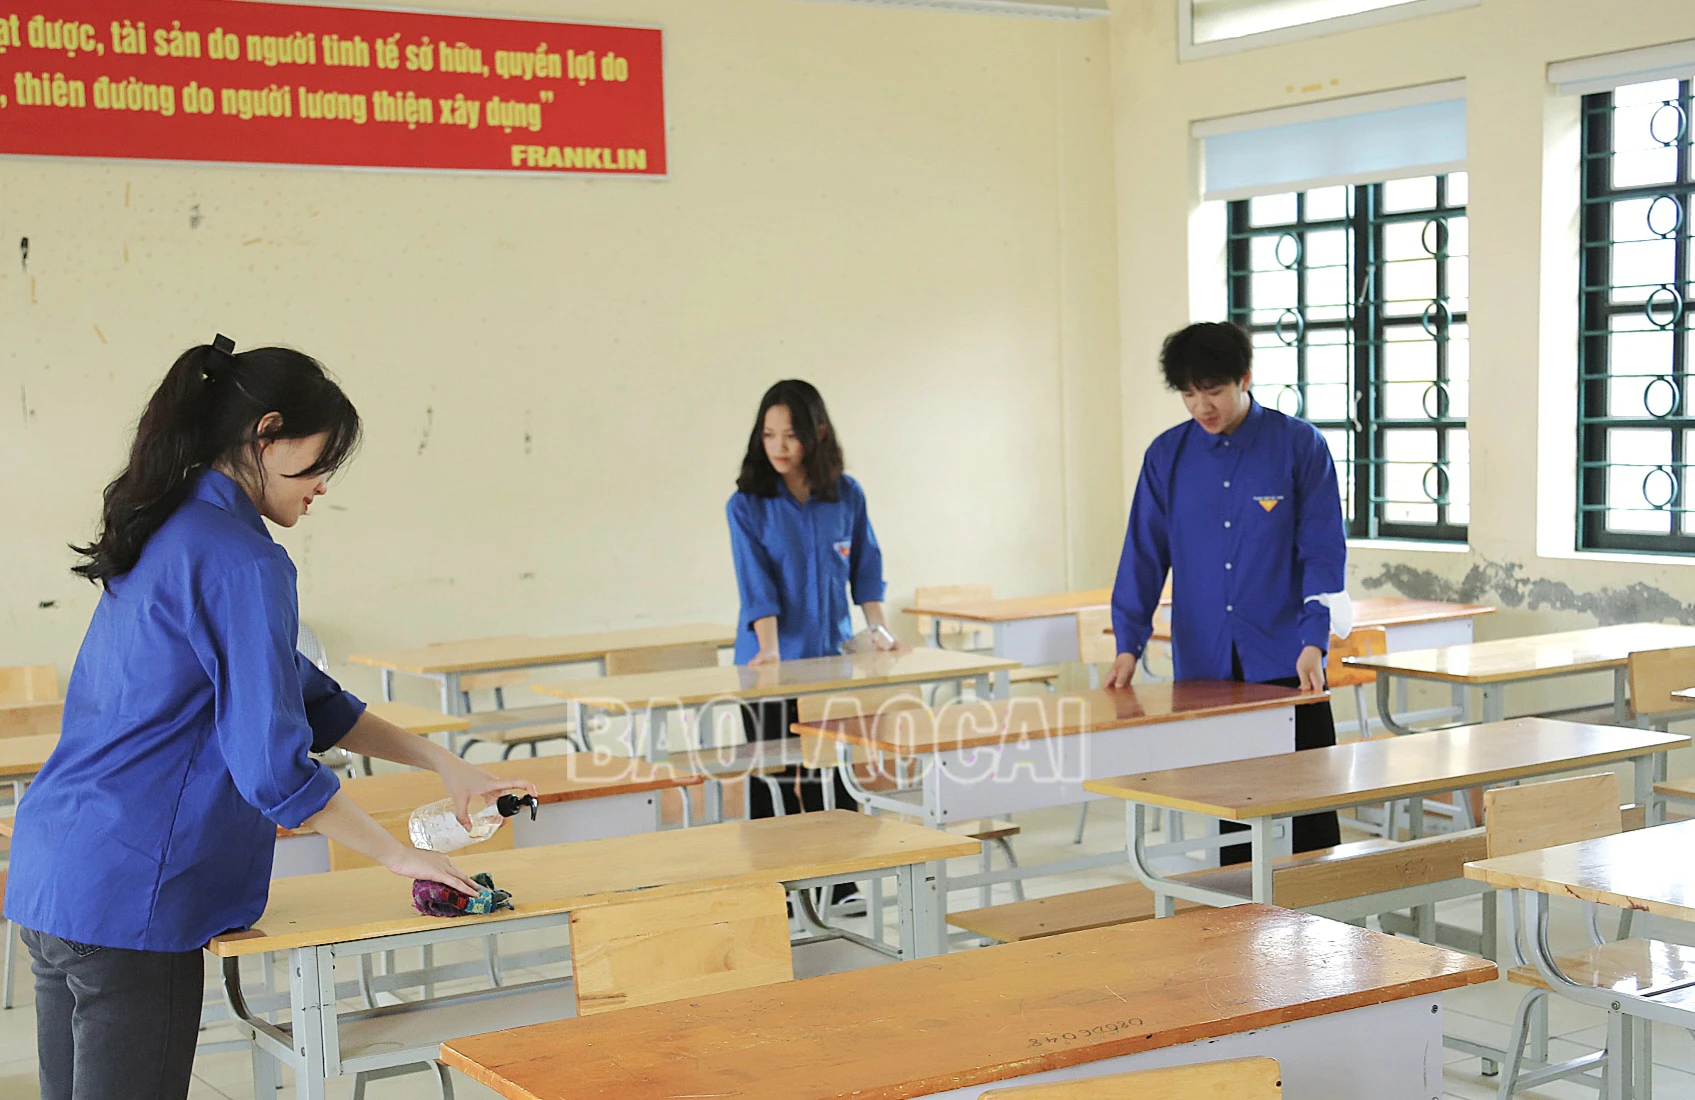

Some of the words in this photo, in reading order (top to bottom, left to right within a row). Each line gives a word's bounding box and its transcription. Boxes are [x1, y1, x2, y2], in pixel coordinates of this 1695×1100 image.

[28, 15, 105, 58] được,
[111, 19, 147, 54] tài
[154, 20, 201, 58] sản
[208, 27, 240, 60] do
[246, 31, 316, 67] người
[322, 34, 370, 67] tinh
[375, 32, 401, 69] tế
[406, 36, 434, 71] sở
[439, 41, 490, 77] hữu,
[567, 49, 596, 86] lợi
[601, 52, 629, 82] do
[14, 71, 86, 108] thiên
[93, 76, 175, 117] đường
[182, 81, 215, 115] do
[221, 84, 292, 120] người
[299, 86, 367, 125] lương
[372, 90, 433, 130] thiện
[439, 93, 480, 130] xây
[511, 144, 647, 170] FRANKLIN
